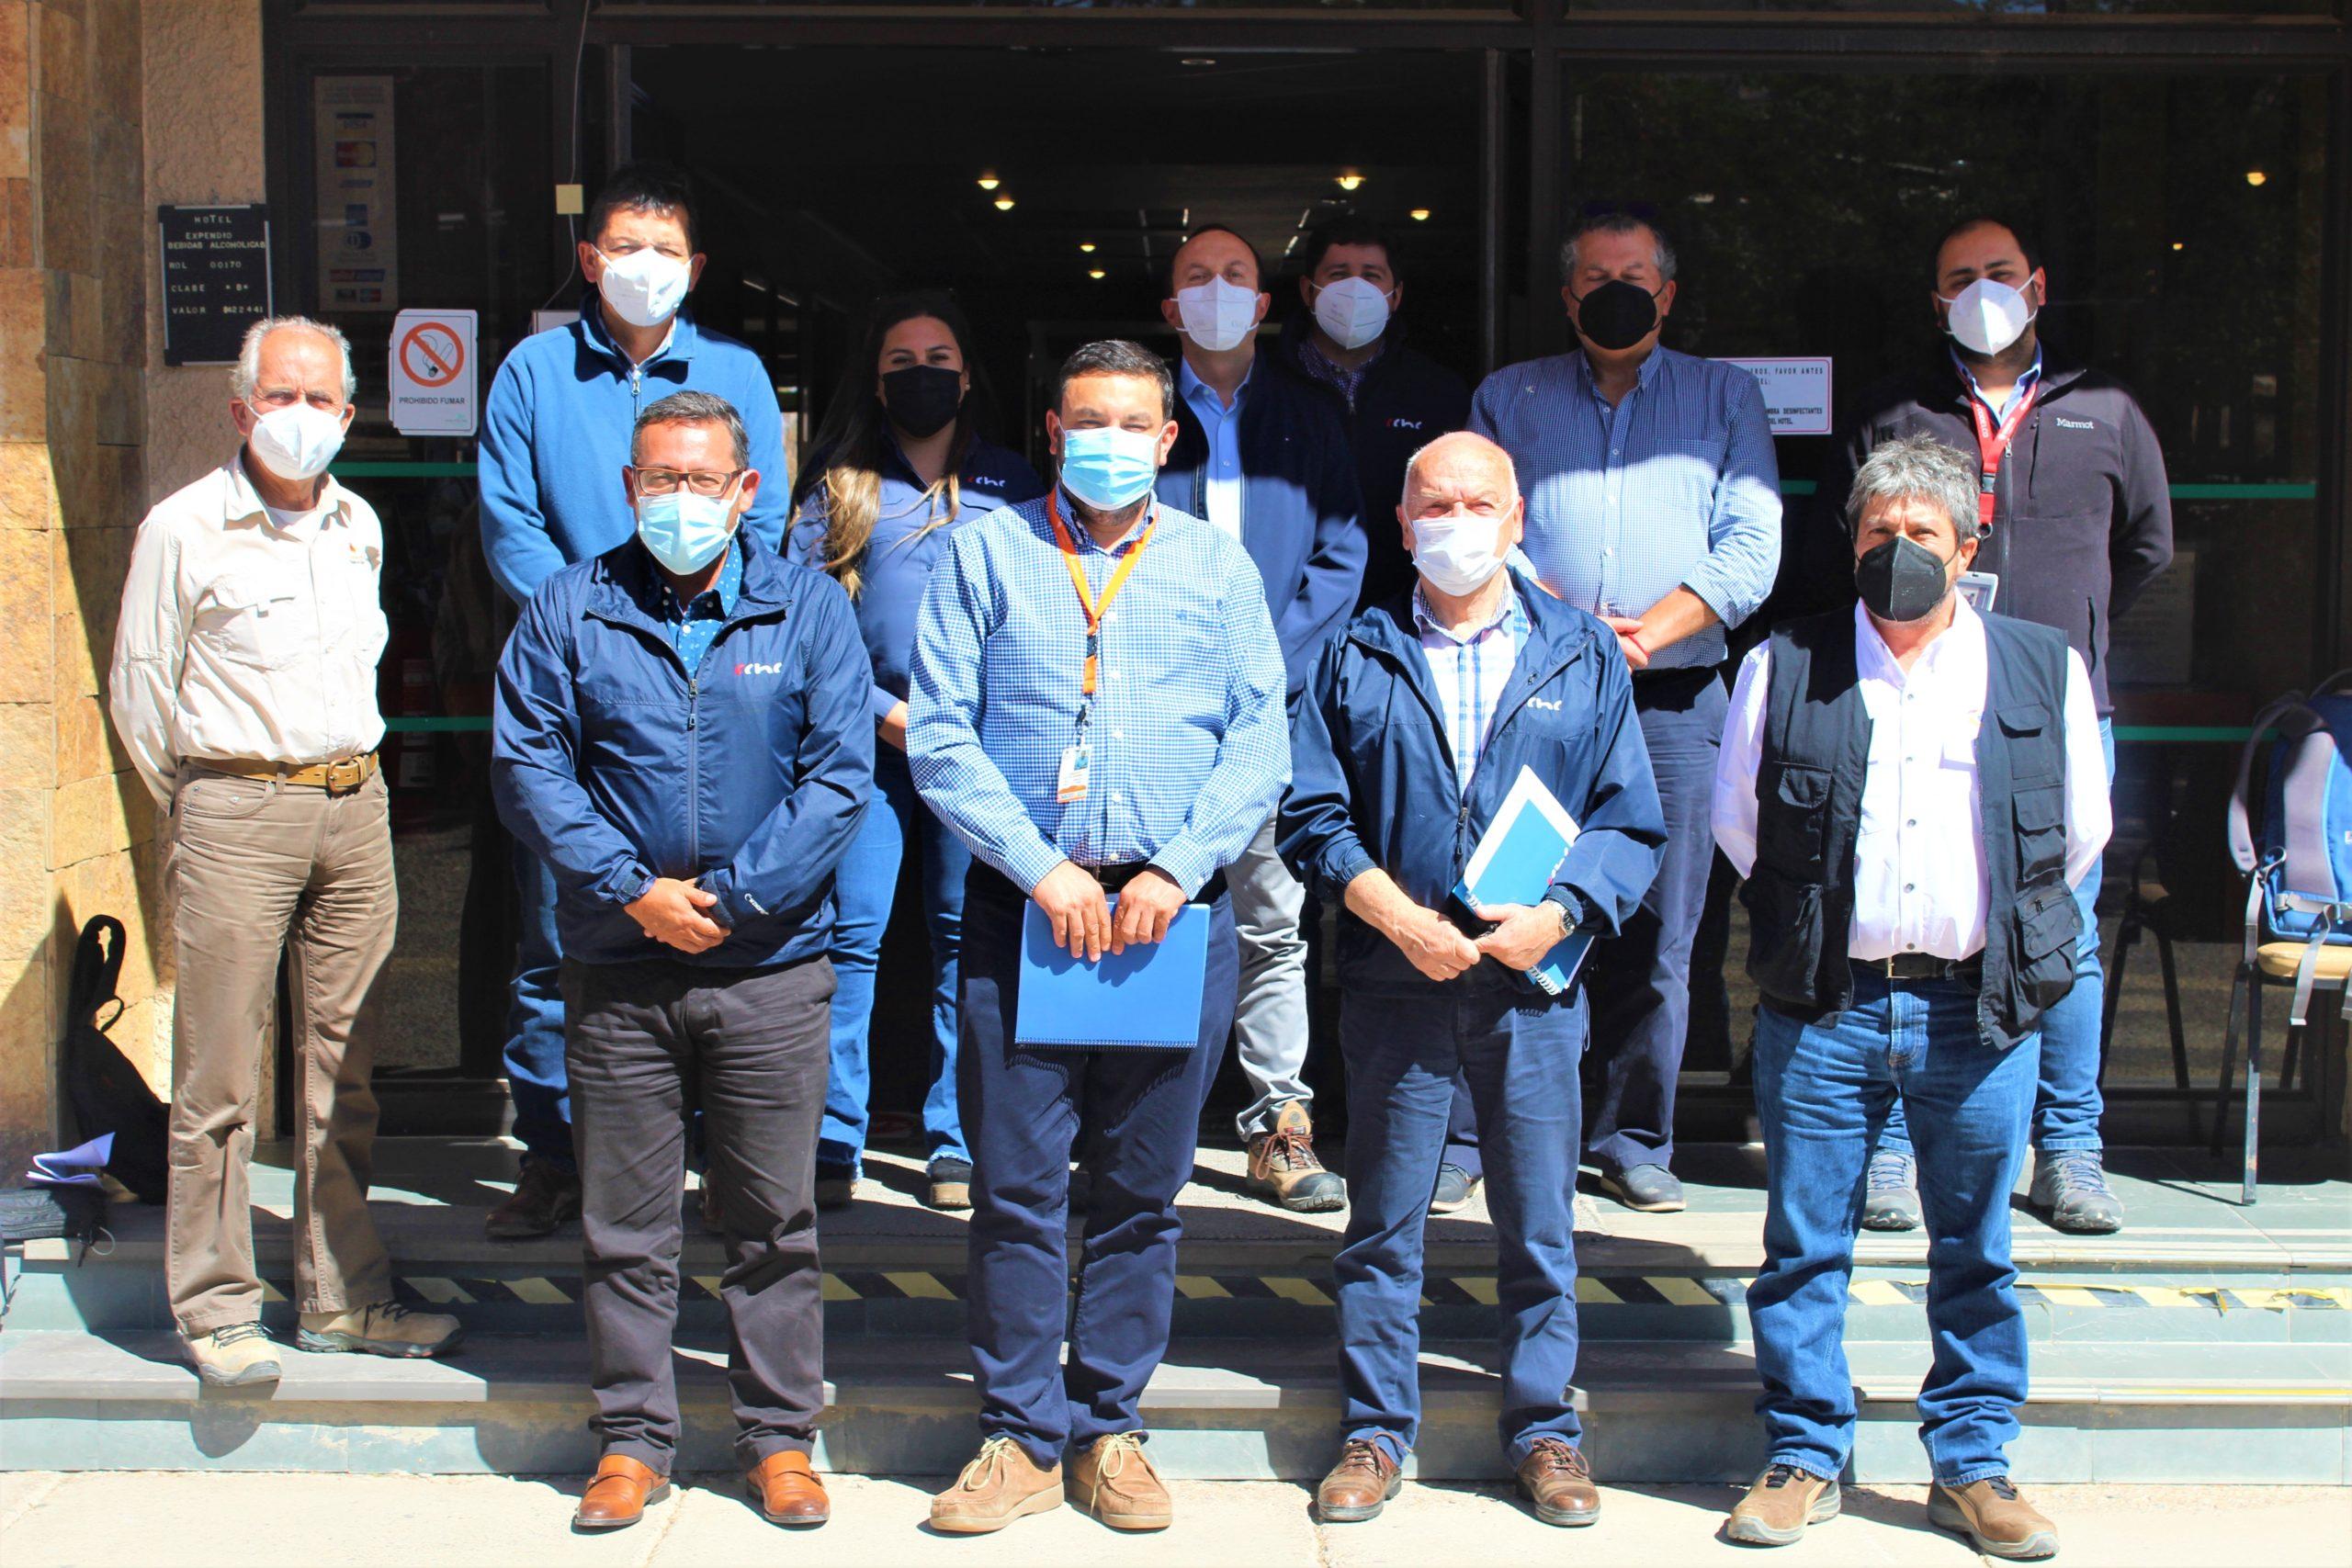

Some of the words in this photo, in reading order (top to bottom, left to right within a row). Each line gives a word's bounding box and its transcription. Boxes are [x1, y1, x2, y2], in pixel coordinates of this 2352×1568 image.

[194, 214, 232, 224] HOTEL
[186, 231, 232, 240] EXPENDIO
[167, 242, 203, 250] BEBIDAS
[209, 241, 266, 249] ALCOHOLICAS
[209, 261, 243, 269] 00170
[171, 284, 206, 293] CLASE
[399, 397, 438, 405] PROHIBIDO
[2056, 417, 2095, 430] Marmot
